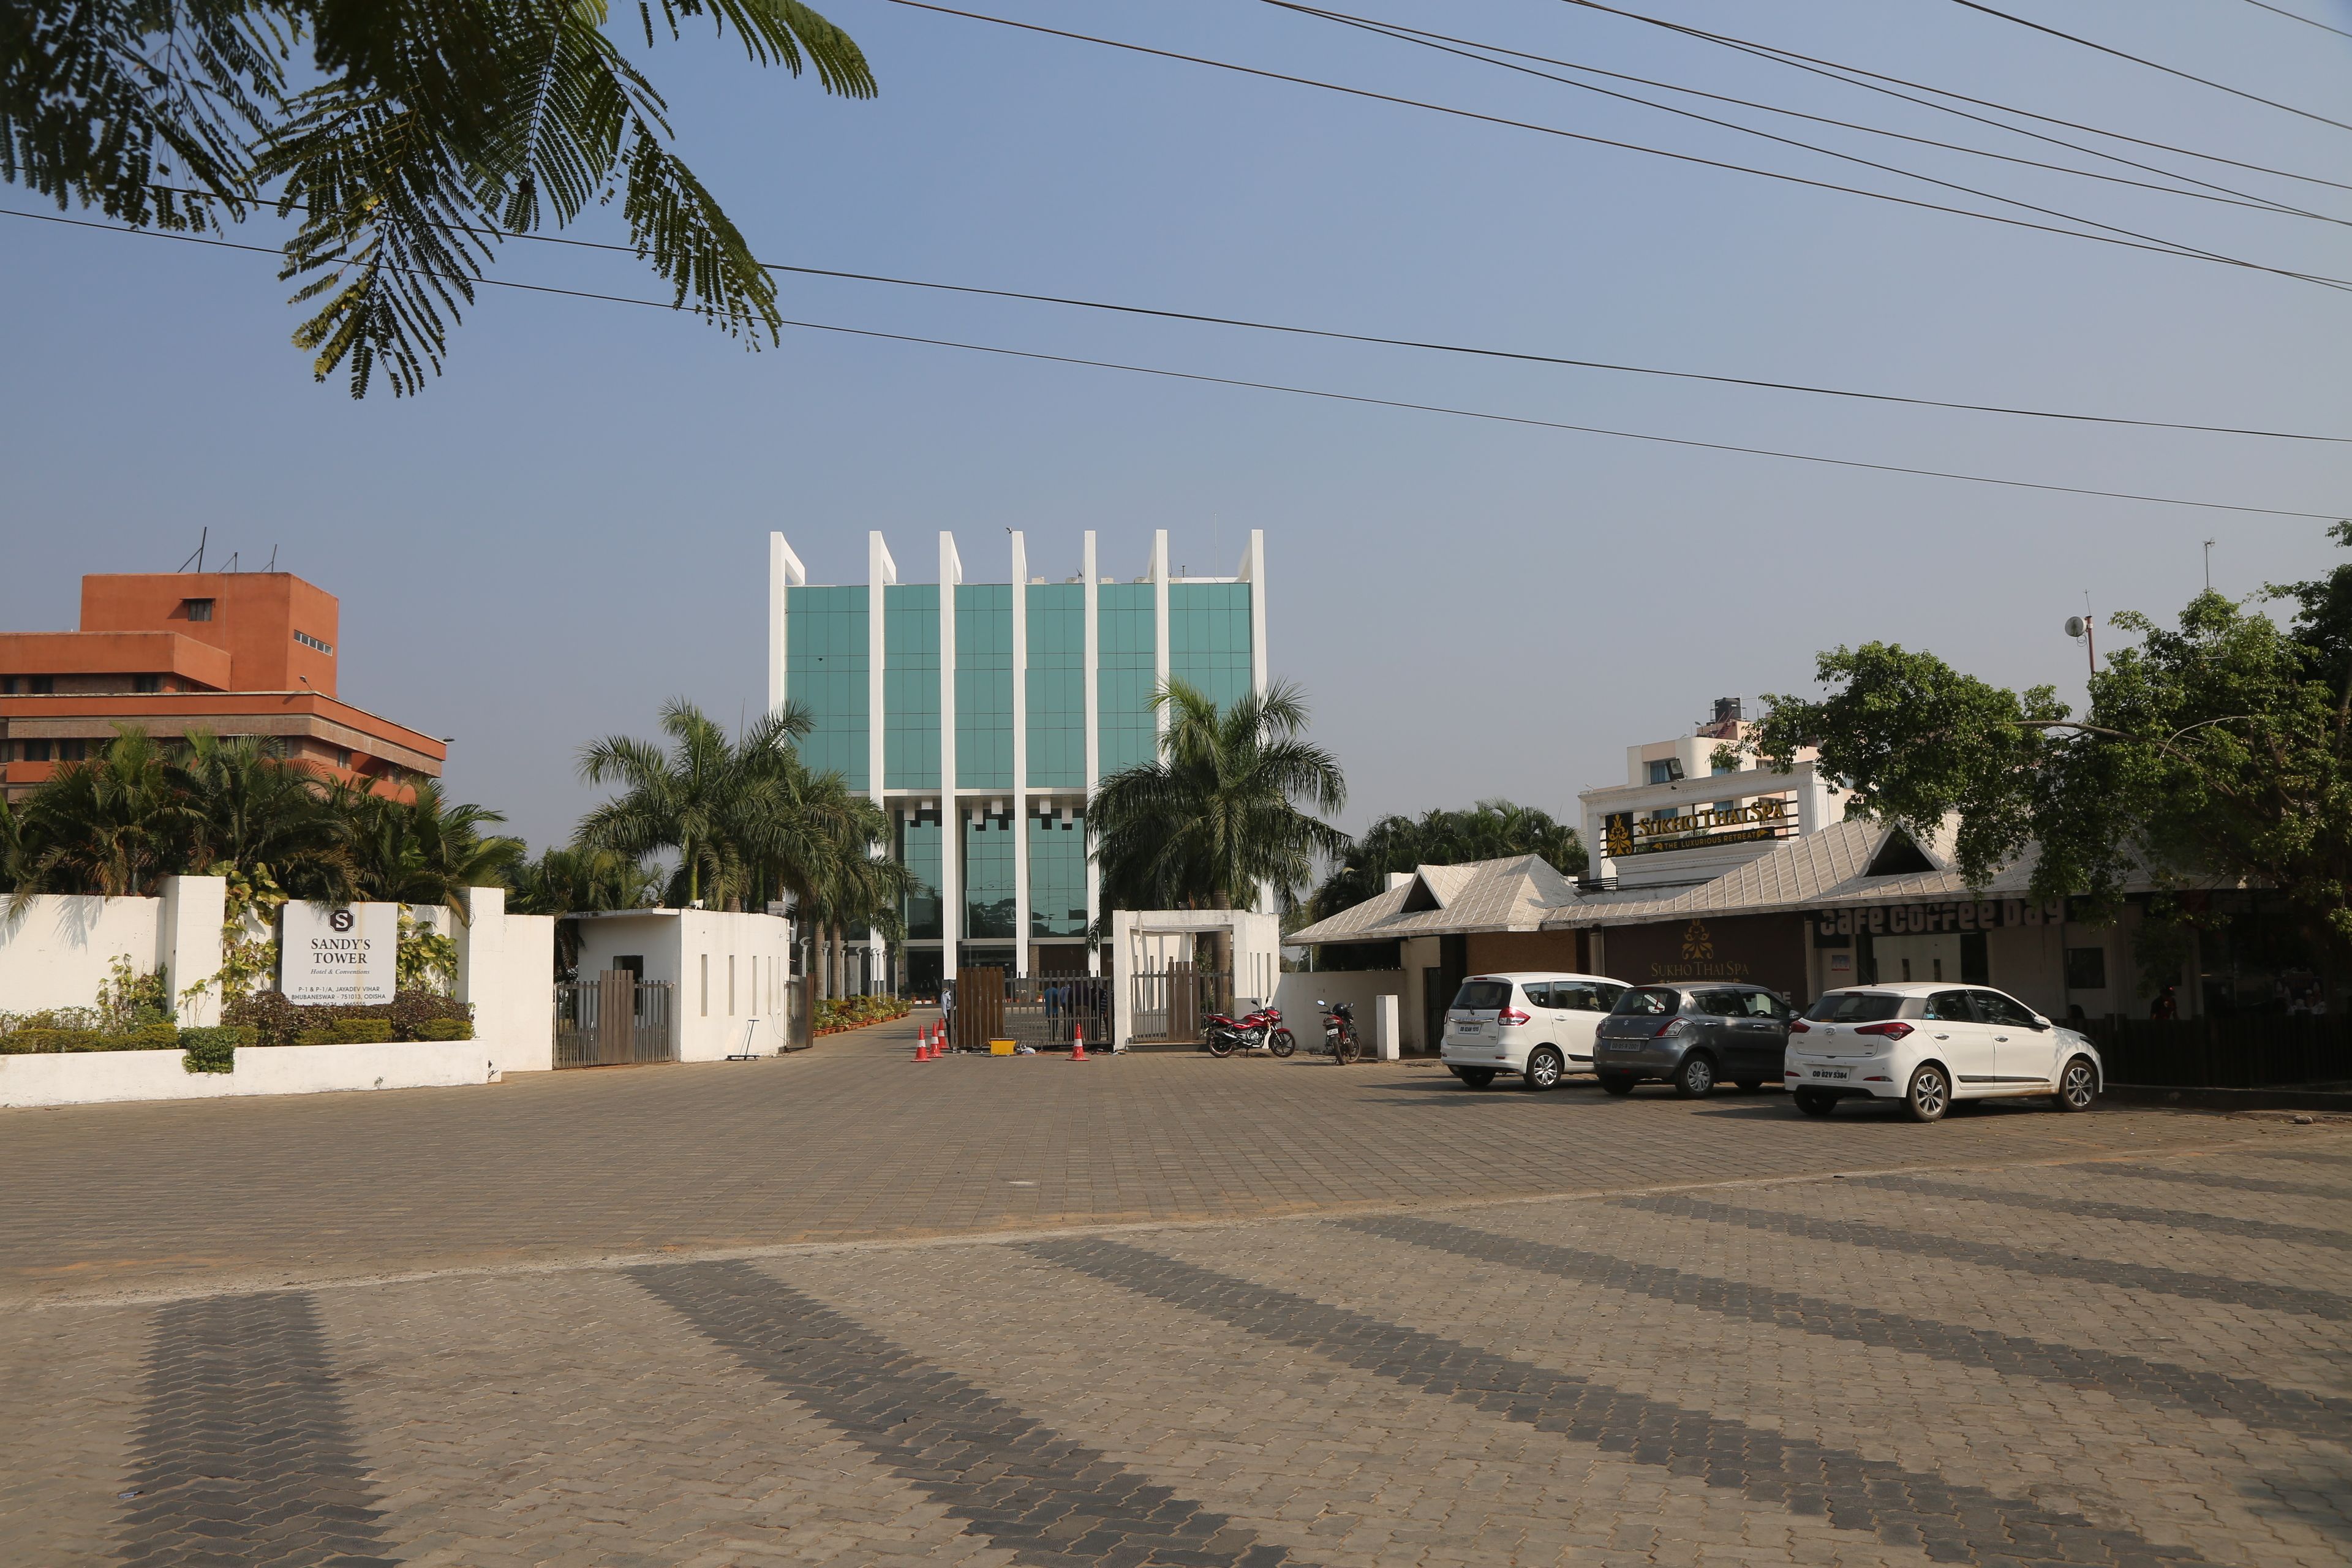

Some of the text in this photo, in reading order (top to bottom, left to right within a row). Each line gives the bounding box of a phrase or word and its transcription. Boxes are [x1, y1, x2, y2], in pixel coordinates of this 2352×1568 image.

[1638, 802, 1785, 837] SUKHO THAI SPA
[1681, 836, 1721, 848] LUXURIOUS
[1724, 832, 1756, 842] RETREAT
[311, 938, 371, 950] SANDY'S
[313, 952, 368, 964] TOWER
[1651, 961, 1750, 977] SUKHO THAI SPA
